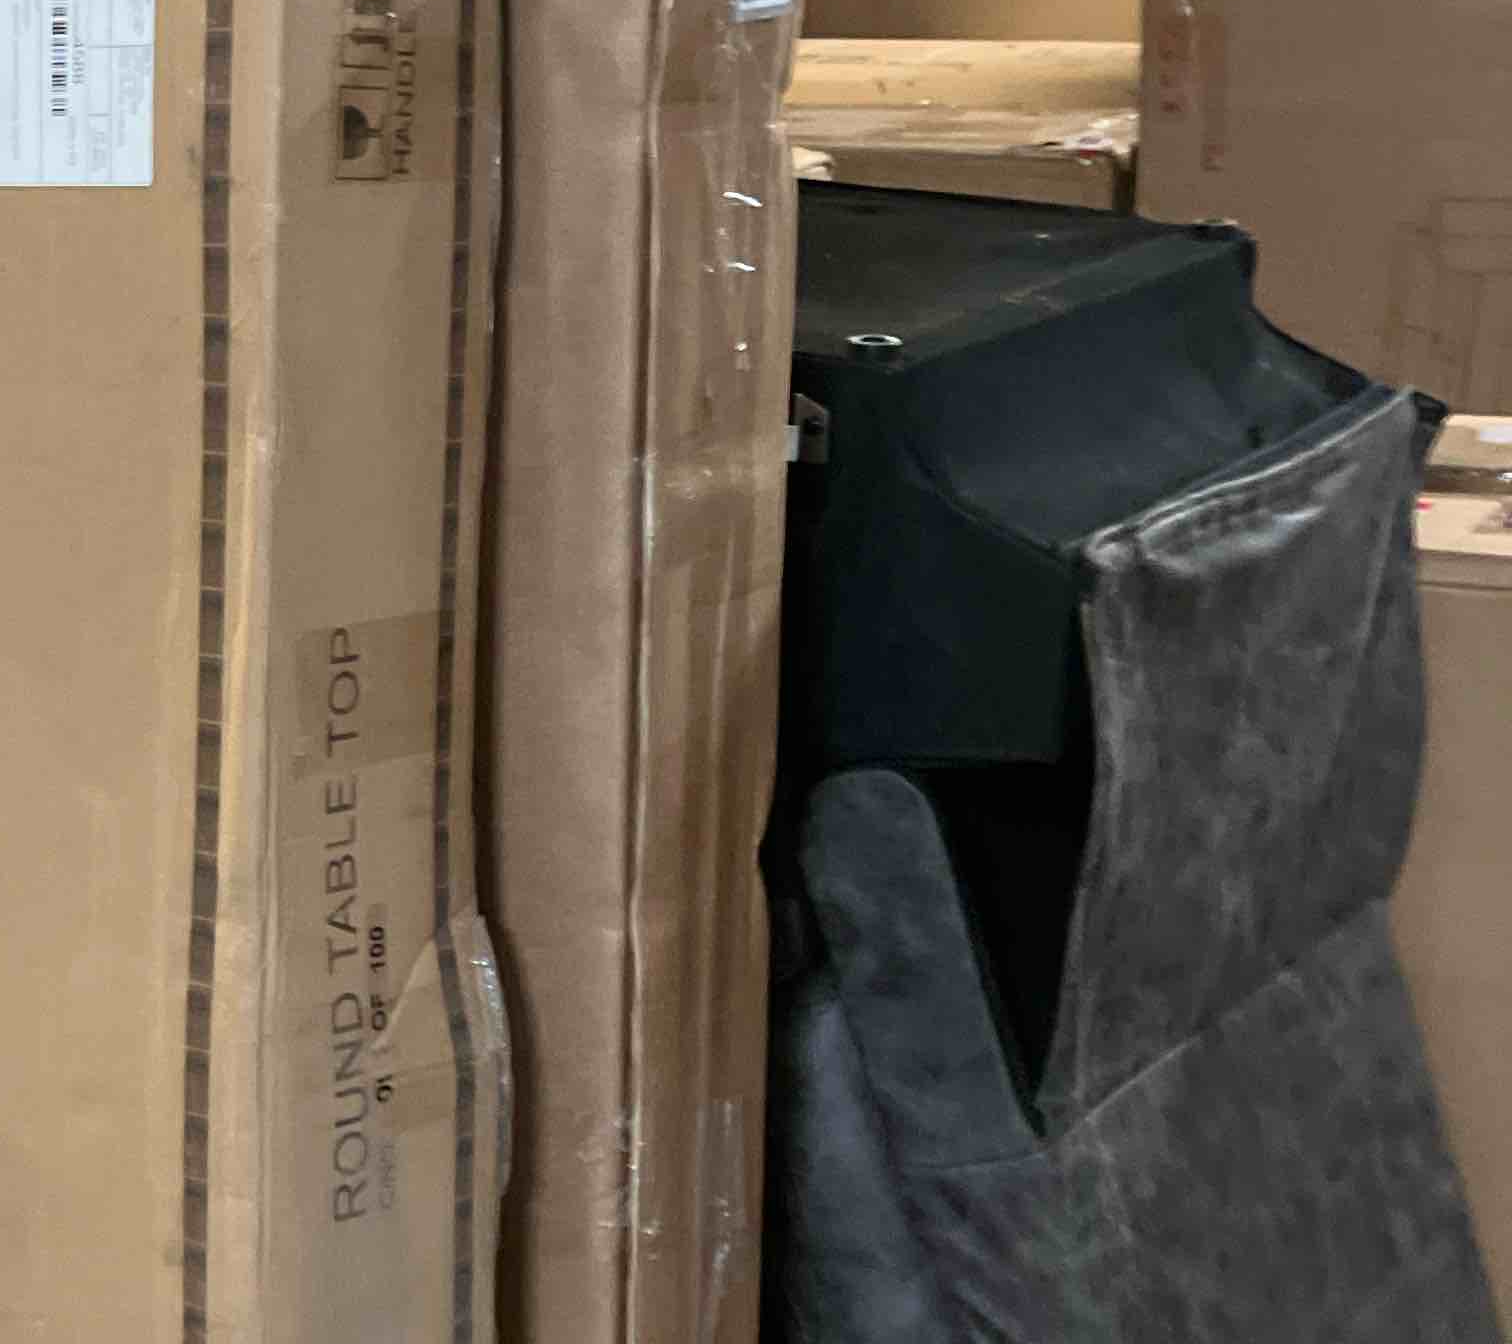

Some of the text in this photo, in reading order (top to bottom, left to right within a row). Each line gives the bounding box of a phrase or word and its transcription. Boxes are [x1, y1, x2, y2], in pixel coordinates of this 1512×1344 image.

[322, 626, 368, 1223] ROUND TABLE TOP
[368, 926, 386, 974] 100
